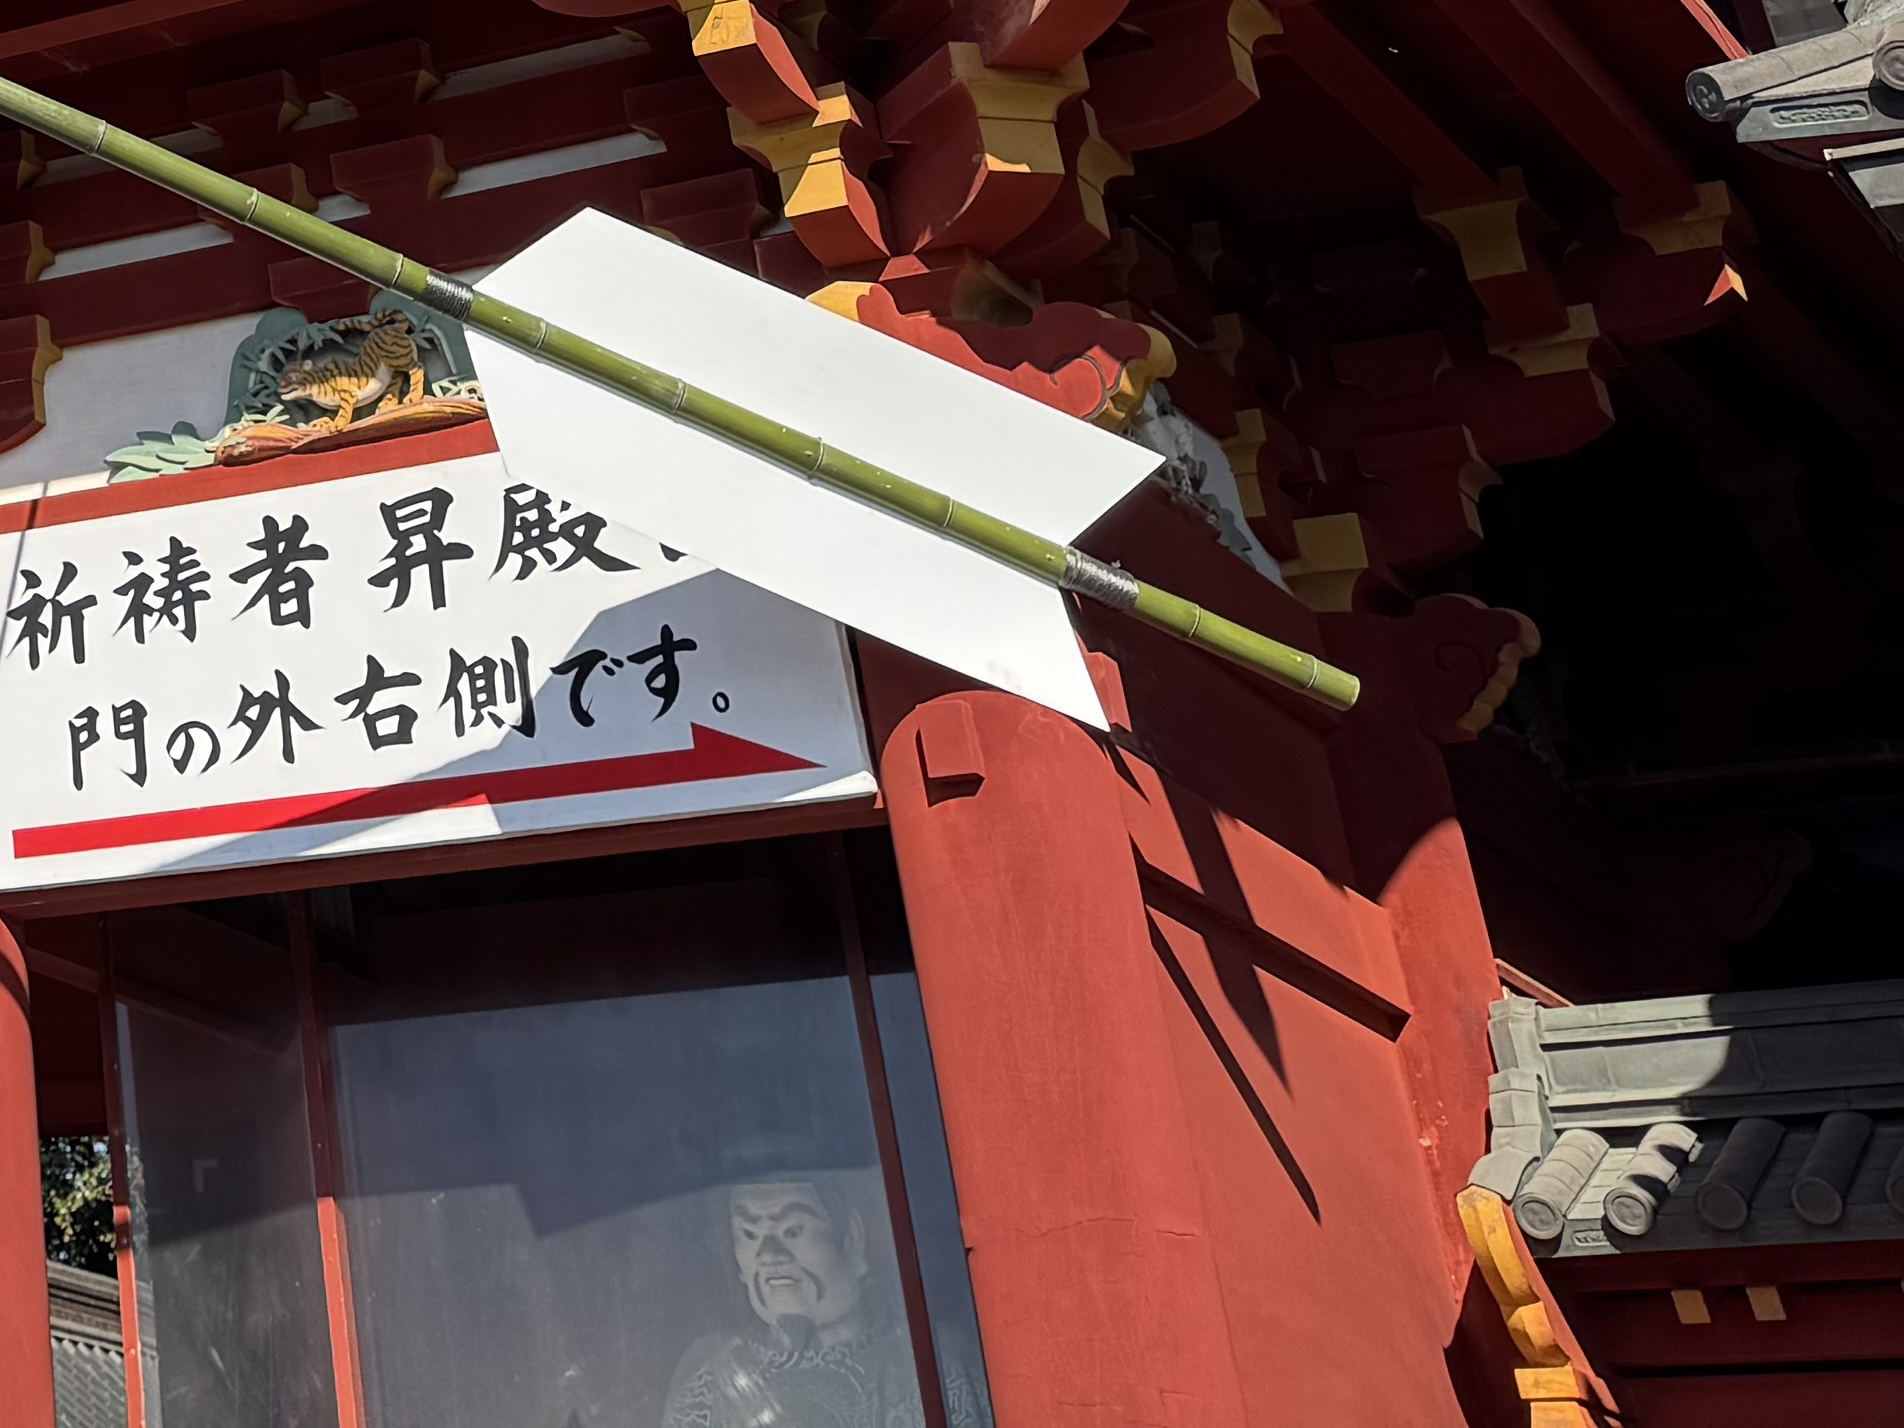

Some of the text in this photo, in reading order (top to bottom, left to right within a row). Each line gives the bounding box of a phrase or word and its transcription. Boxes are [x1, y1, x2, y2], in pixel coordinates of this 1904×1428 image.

[4, 482, 689, 672] 祈祷者昇殿
[65, 622, 732, 792] 門の外右側です。
